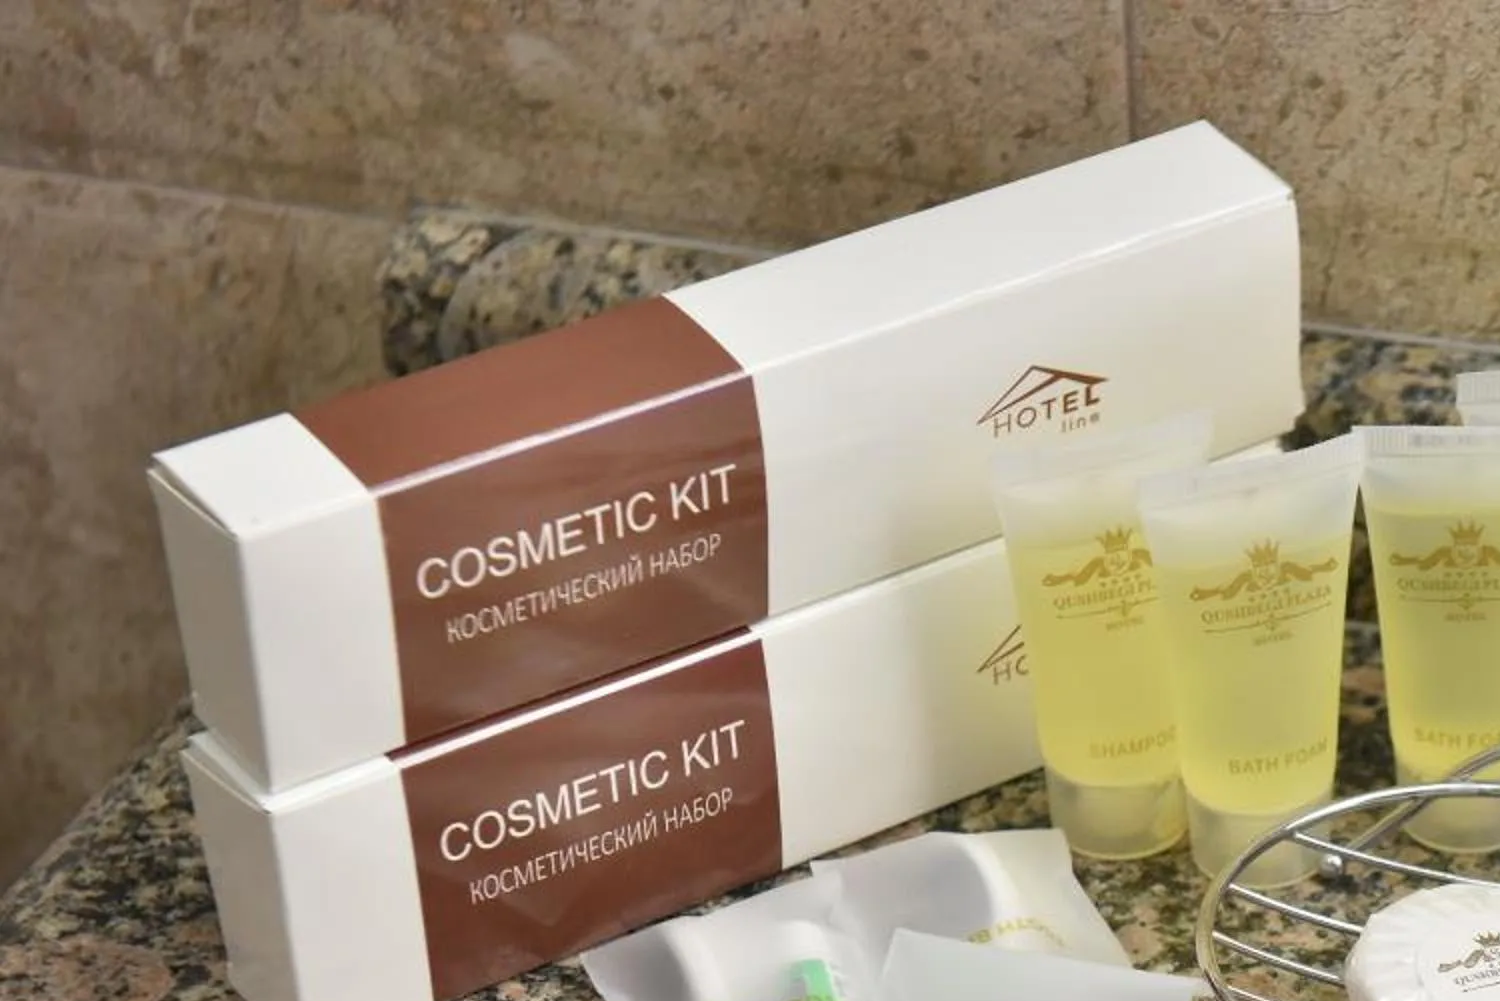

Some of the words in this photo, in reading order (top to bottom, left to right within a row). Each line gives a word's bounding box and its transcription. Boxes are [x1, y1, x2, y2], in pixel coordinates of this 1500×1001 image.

[993, 383, 1101, 438] HOTEL
[1061, 412, 1100, 433] line
[416, 490, 657, 599] COSMETIC
[669, 463, 737, 521] KIT
[446, 553, 644, 643] КОСМЕТИЧЕСКИЙ
[650, 532, 722, 577] НАБОР
[440, 750, 670, 862] COSMETIC
[681, 719, 746, 778] KIT
[469, 811, 658, 905] КОСМЕТИЧЕСКИЙ
[664, 787, 733, 831] НАБОР
